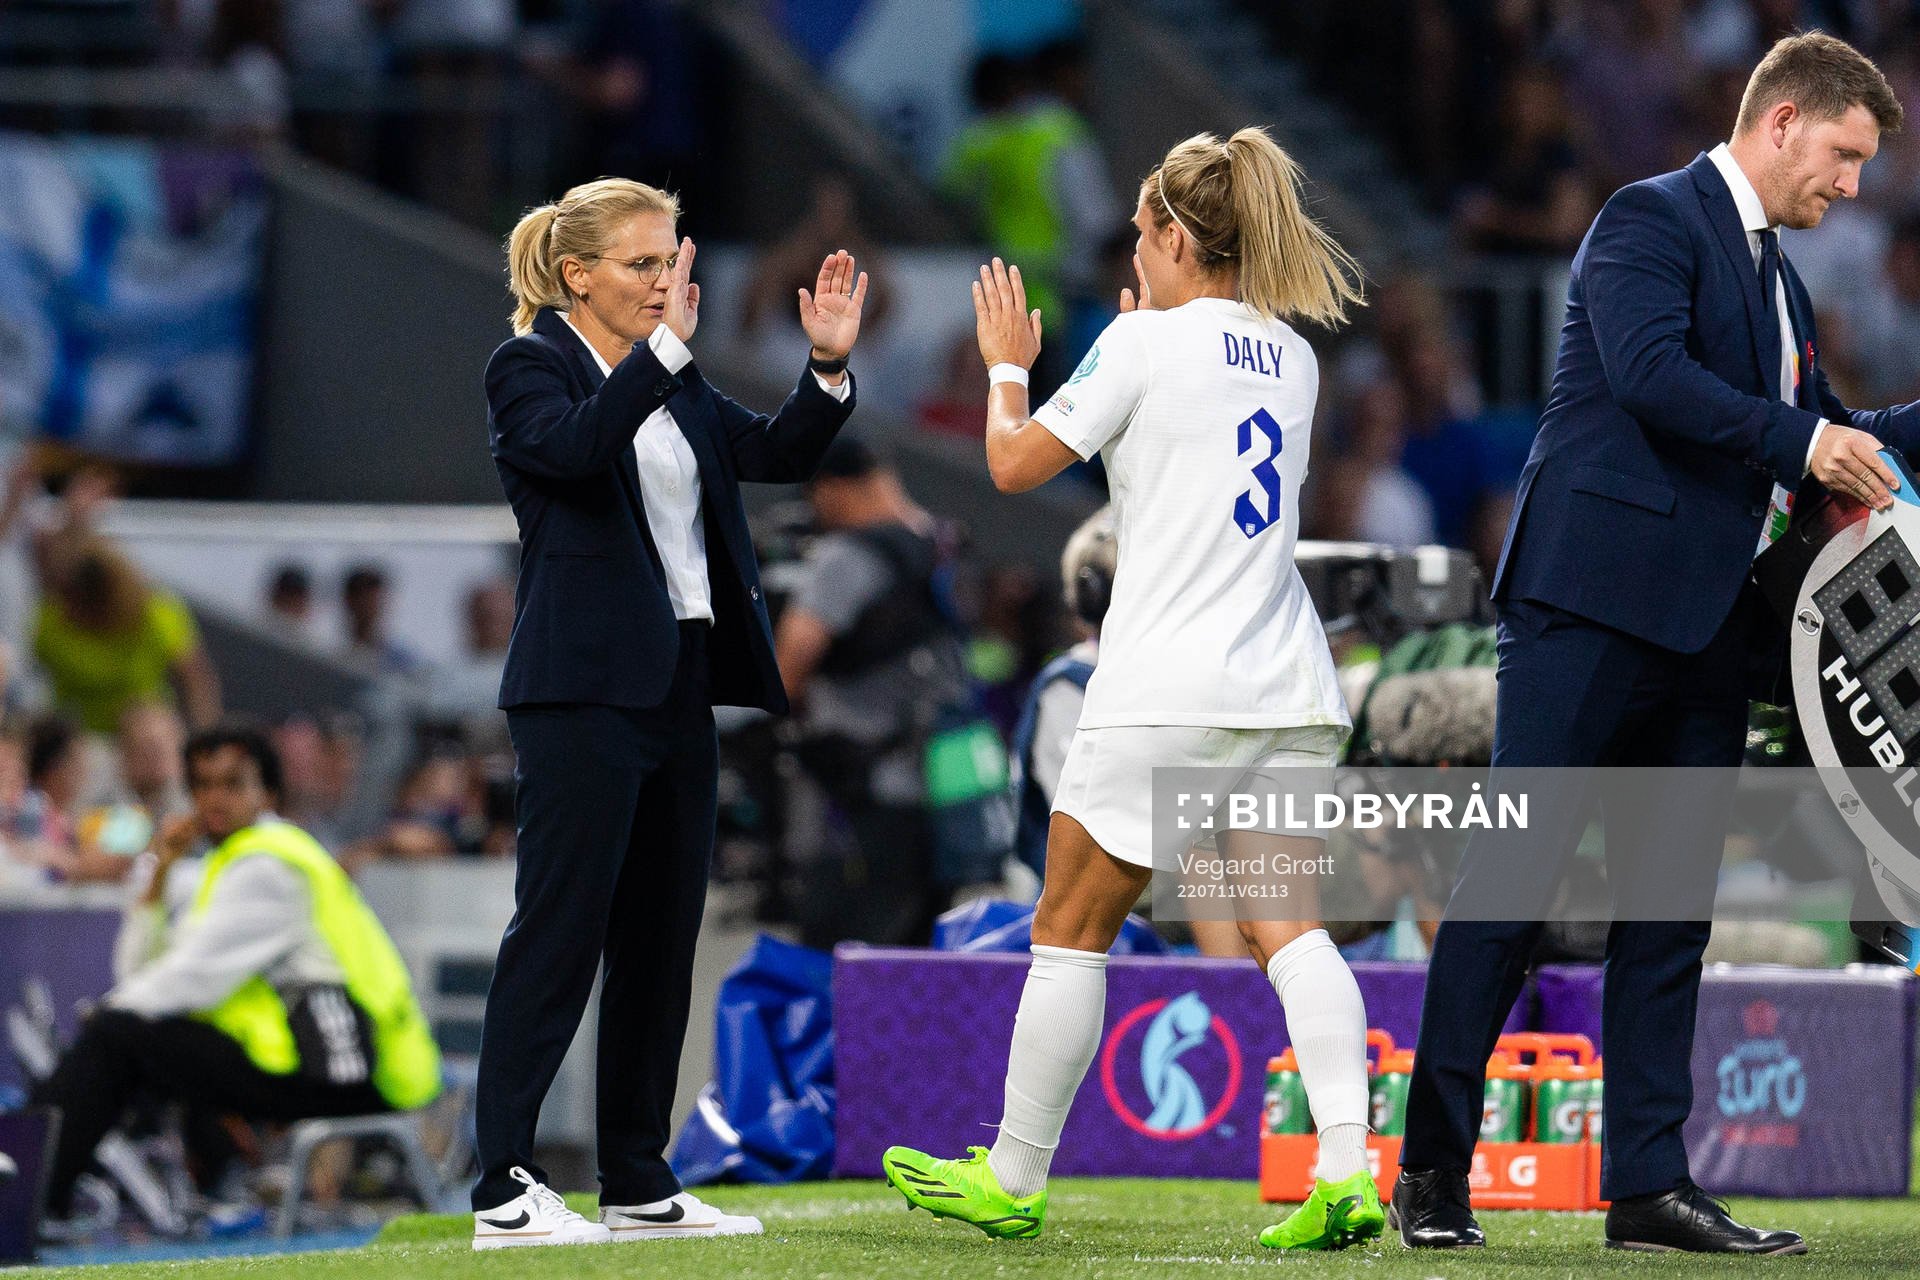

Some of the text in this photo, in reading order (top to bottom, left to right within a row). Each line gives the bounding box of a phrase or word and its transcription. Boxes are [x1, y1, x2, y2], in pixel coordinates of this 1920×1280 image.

[1223, 332, 1283, 378] DALY
[1233, 407, 1283, 539] 3
[1822, 655, 1920, 828] HUBL
[1555, 1100, 1582, 1136] G
[1508, 1155, 1538, 1187] G
